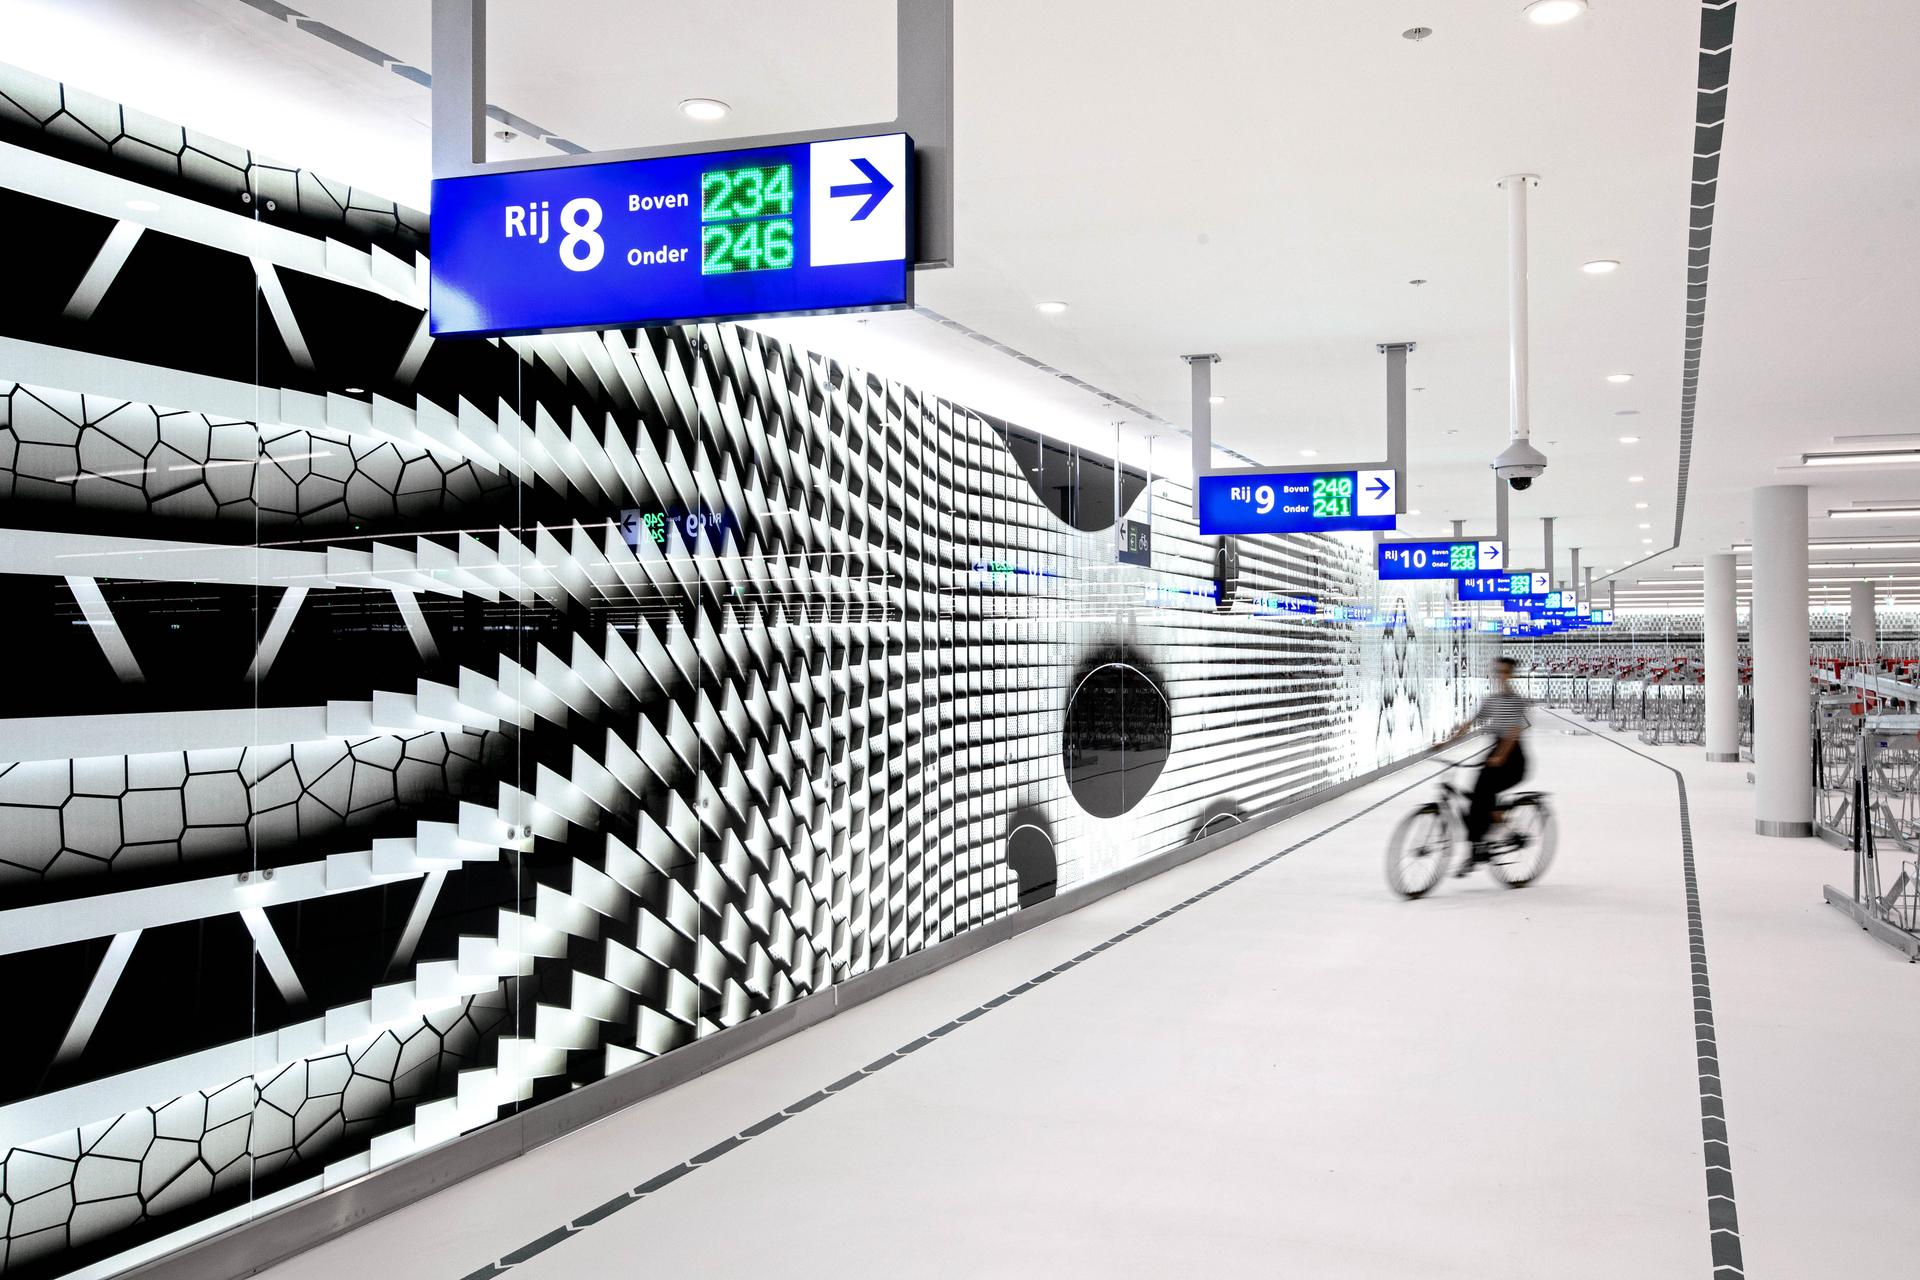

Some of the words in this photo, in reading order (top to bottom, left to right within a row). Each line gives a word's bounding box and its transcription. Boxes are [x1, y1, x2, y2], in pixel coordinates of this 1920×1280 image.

[628, 191, 689, 212] Boven
[702, 164, 793, 220] 234
[504, 200, 550, 244] Rij
[558, 197, 605, 272] 8
[627, 245, 689, 266] Onder
[702, 219, 793, 272] 246
[1283, 485, 1309, 494] Boven
[1313, 478, 1352, 497] 240
[1231, 486, 1251, 503] Rij
[1254, 485, 1275, 515] 9
[1283, 504, 1309, 513] Onder
[1313, 498, 1351, 517] 241
[1384, 550, 1398, 561] Rij
[1400, 549, 1427, 569] 10
[1450, 545, 1476, 559] 237
[1450, 558, 1476, 571] 238
[1465, 578, 1475, 588] Rij
[1476, 578, 1495, 593] 11
